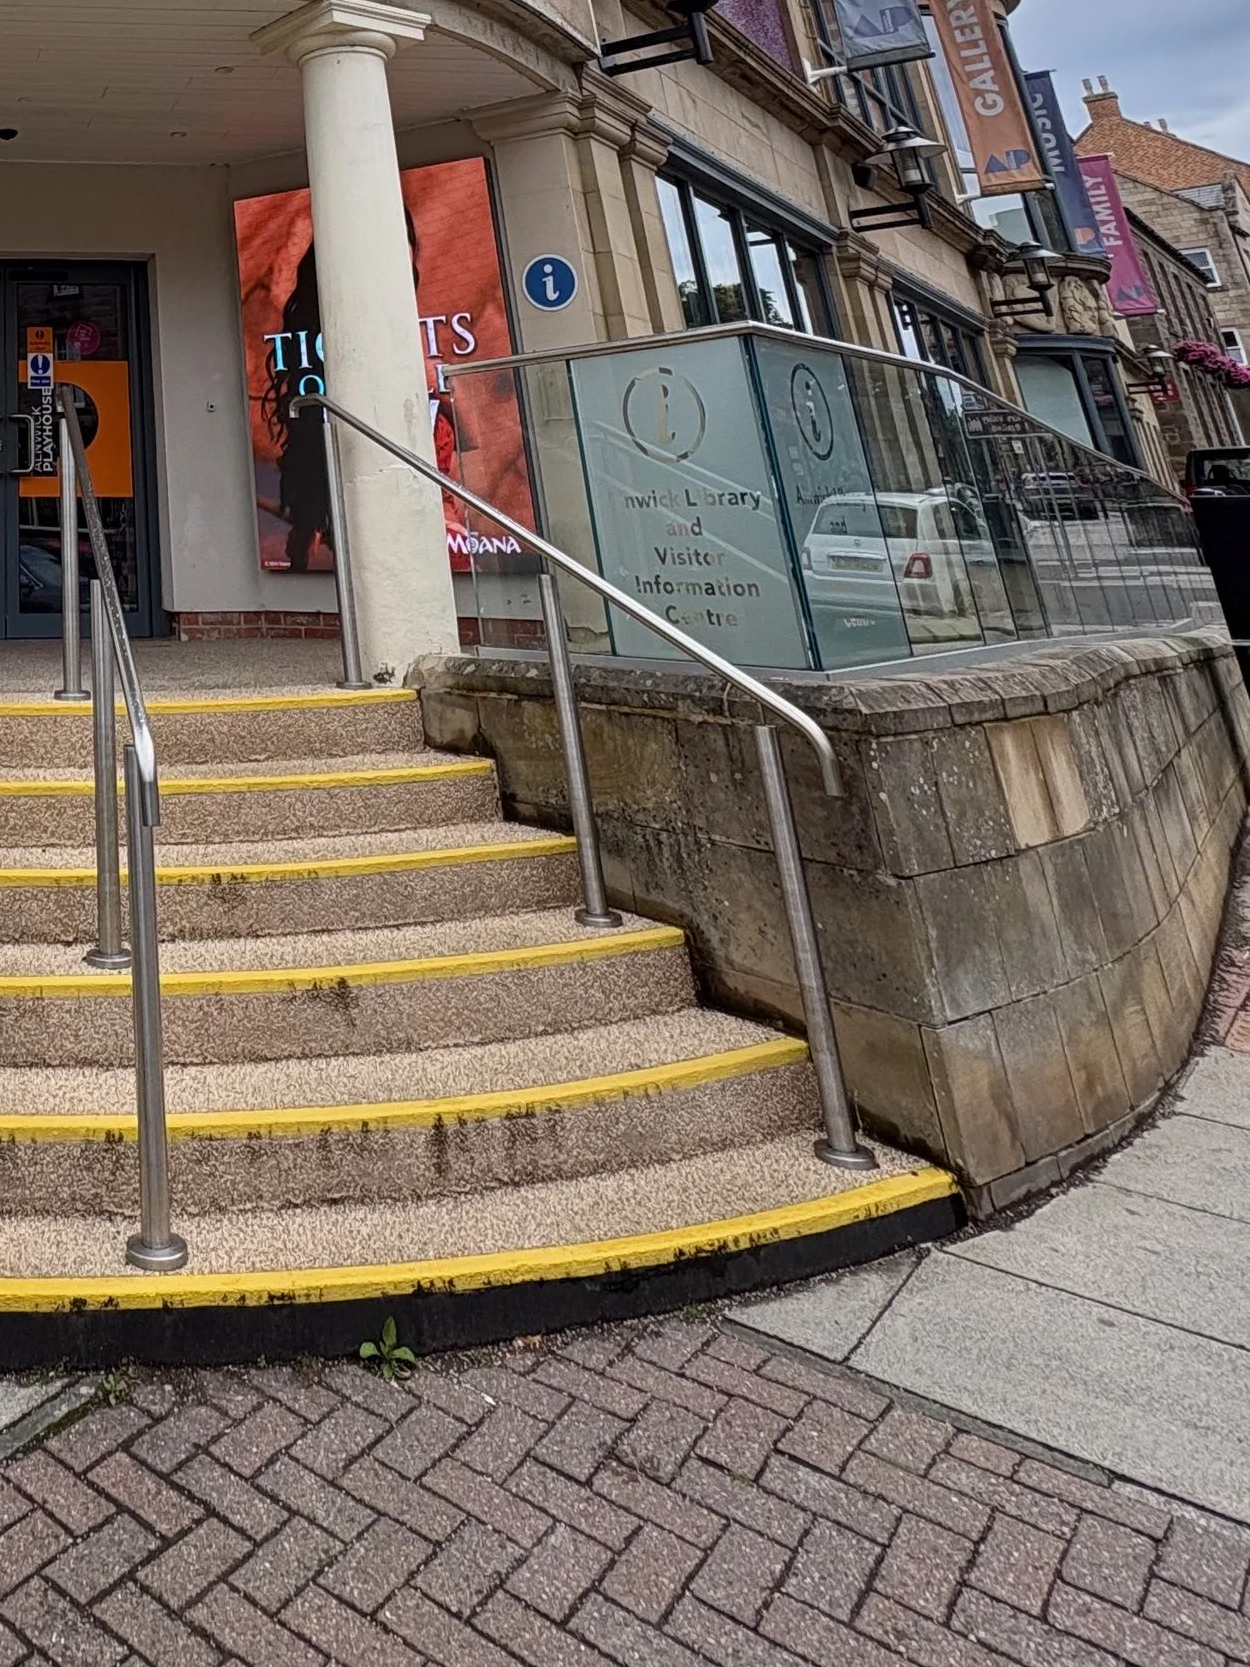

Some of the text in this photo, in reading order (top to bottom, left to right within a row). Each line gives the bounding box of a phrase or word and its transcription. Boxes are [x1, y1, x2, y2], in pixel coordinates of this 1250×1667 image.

[1081, 174, 1123, 247] FAMILY
[42, 388, 53, 472] PLAYHOUSE
[685, 489, 760, 510] Lbrary
[666, 516, 703, 536] and
[447, 532, 522, 554] MOANA
[654, 546, 725, 566] Visitor
[635, 574, 760, 597] Information
